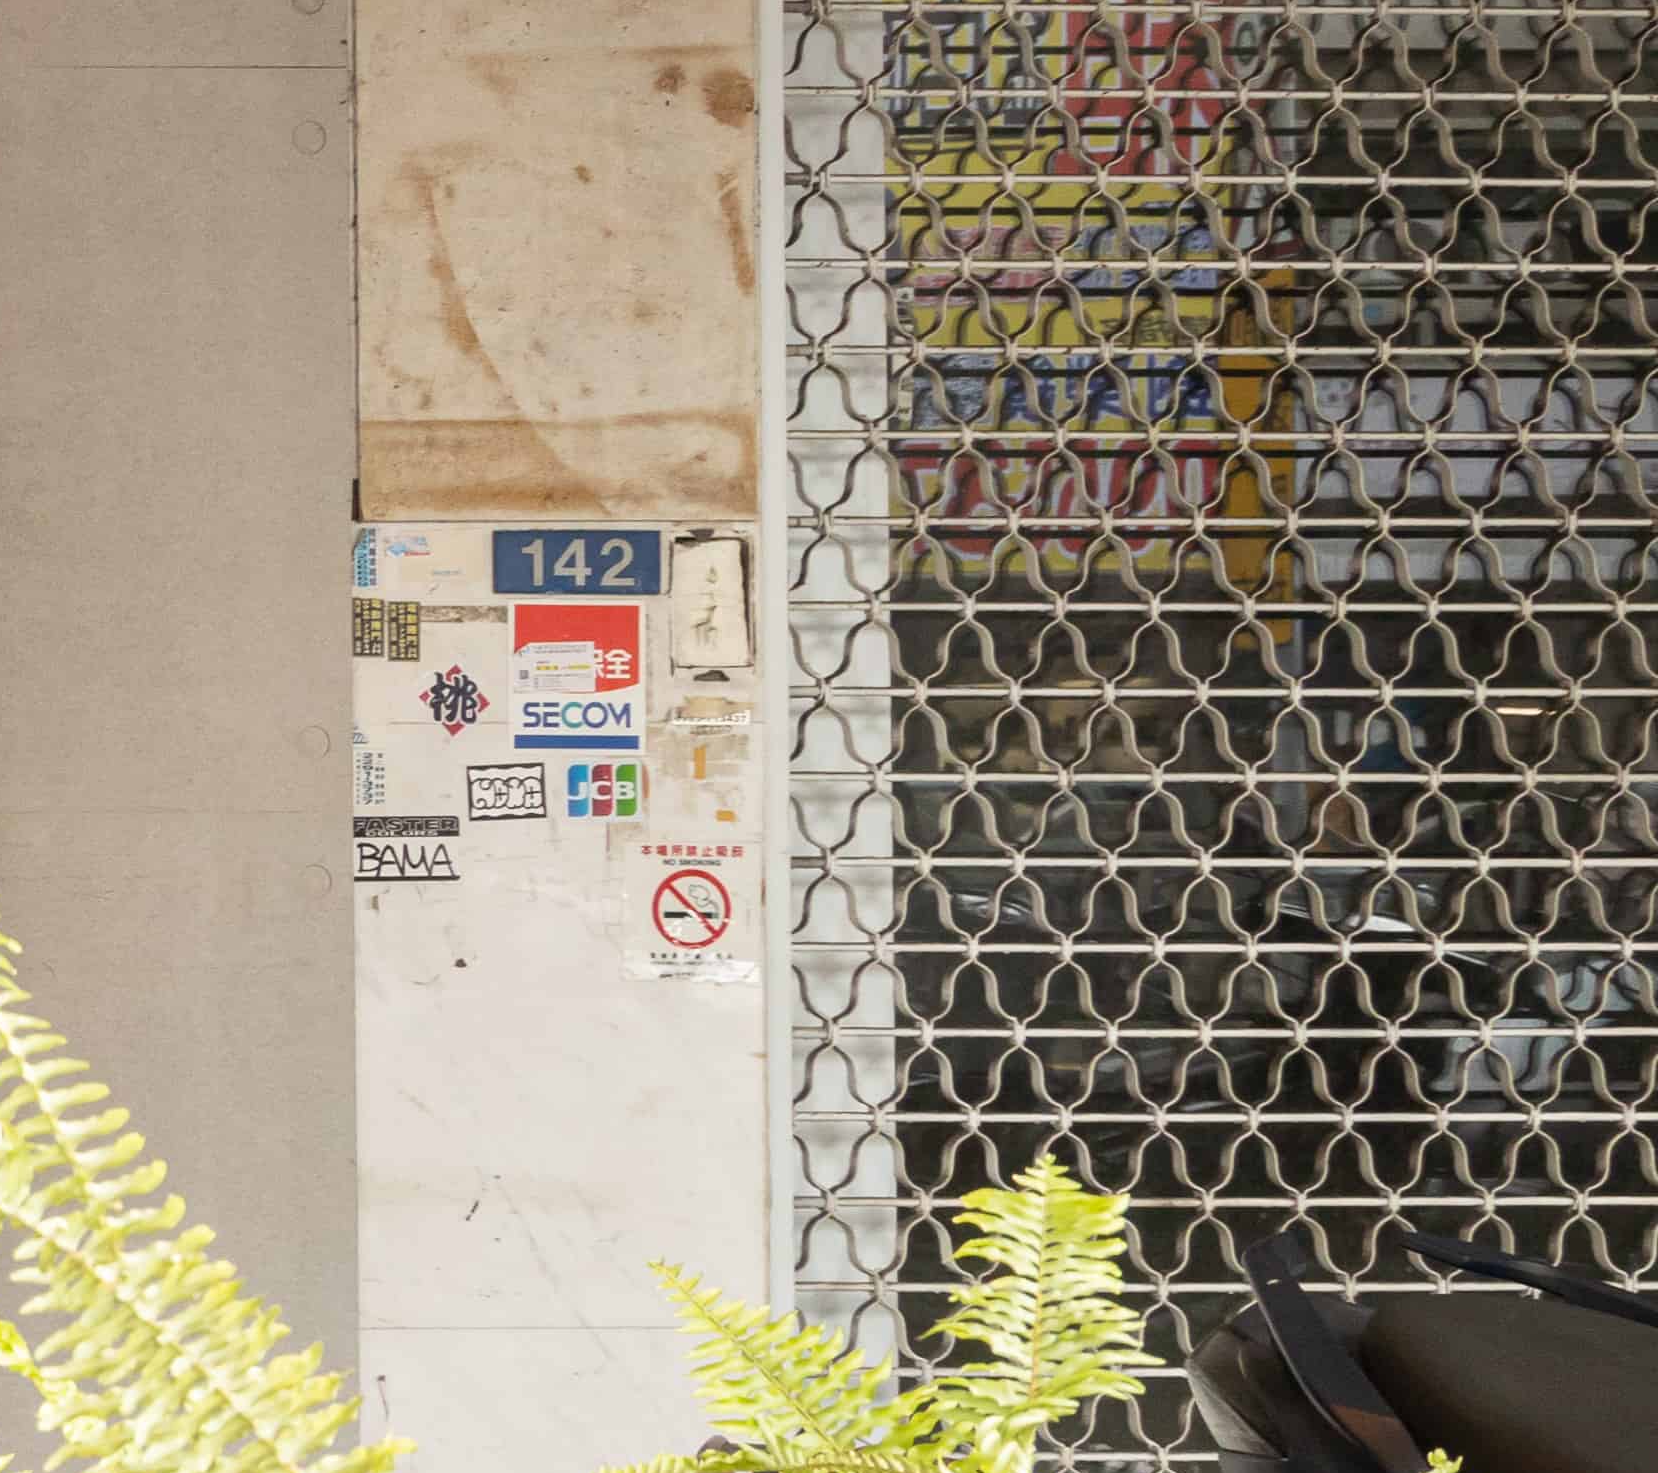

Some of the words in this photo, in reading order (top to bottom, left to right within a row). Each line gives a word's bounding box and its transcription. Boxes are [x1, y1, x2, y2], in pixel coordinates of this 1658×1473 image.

[521, 537, 637, 588] 142
[522, 701, 632, 729] SECOM
[567, 780, 637, 801] JCB
[354, 816, 460, 832] FASTER
[662, 858, 676, 866] NO
[679, 858, 722, 867] SMOKING
